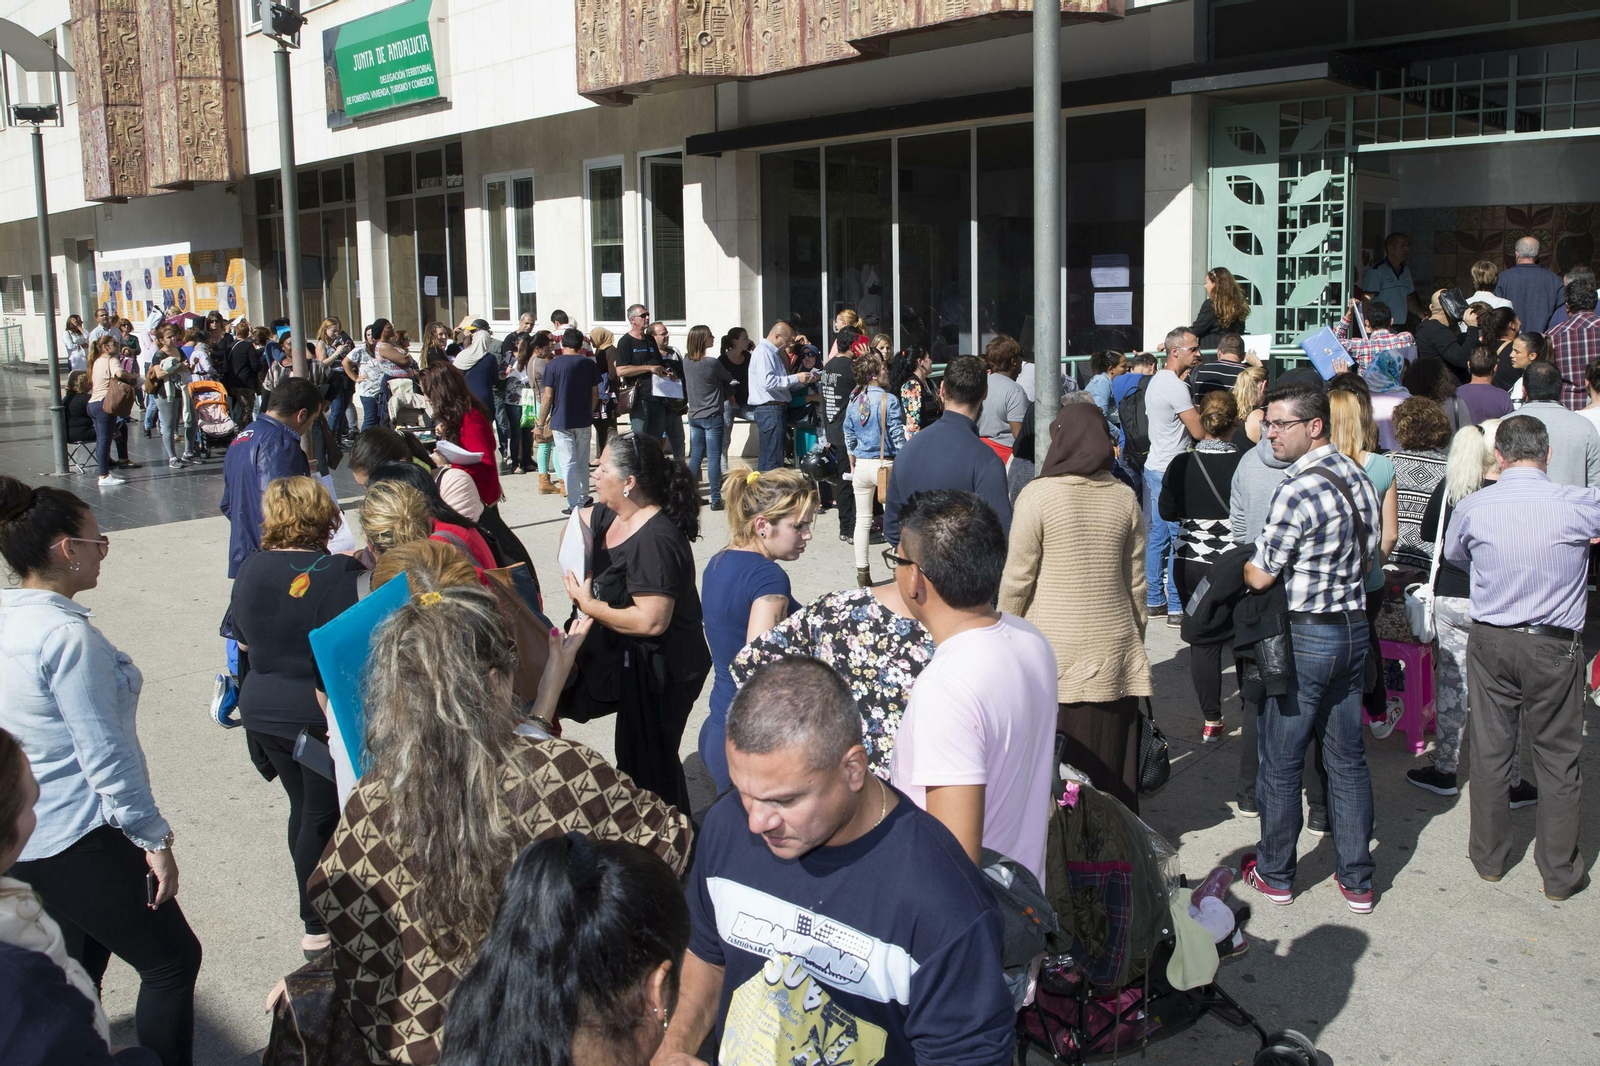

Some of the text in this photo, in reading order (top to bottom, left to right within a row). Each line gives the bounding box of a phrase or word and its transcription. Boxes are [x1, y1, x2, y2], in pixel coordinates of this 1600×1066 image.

[353, 50, 375, 72] JUNTA
[375, 46, 386, 65] DE
[380, 63, 433, 84] DELEGACIÓN TERRITORIAL
[346, 97, 352, 105] DE
[352, 92, 372, 104] FOMENTO,
[390, 82, 408, 94] TURISMO
[411, 76, 434, 89] COMERCIO
[1408, 79, 1446, 109] JUTA
